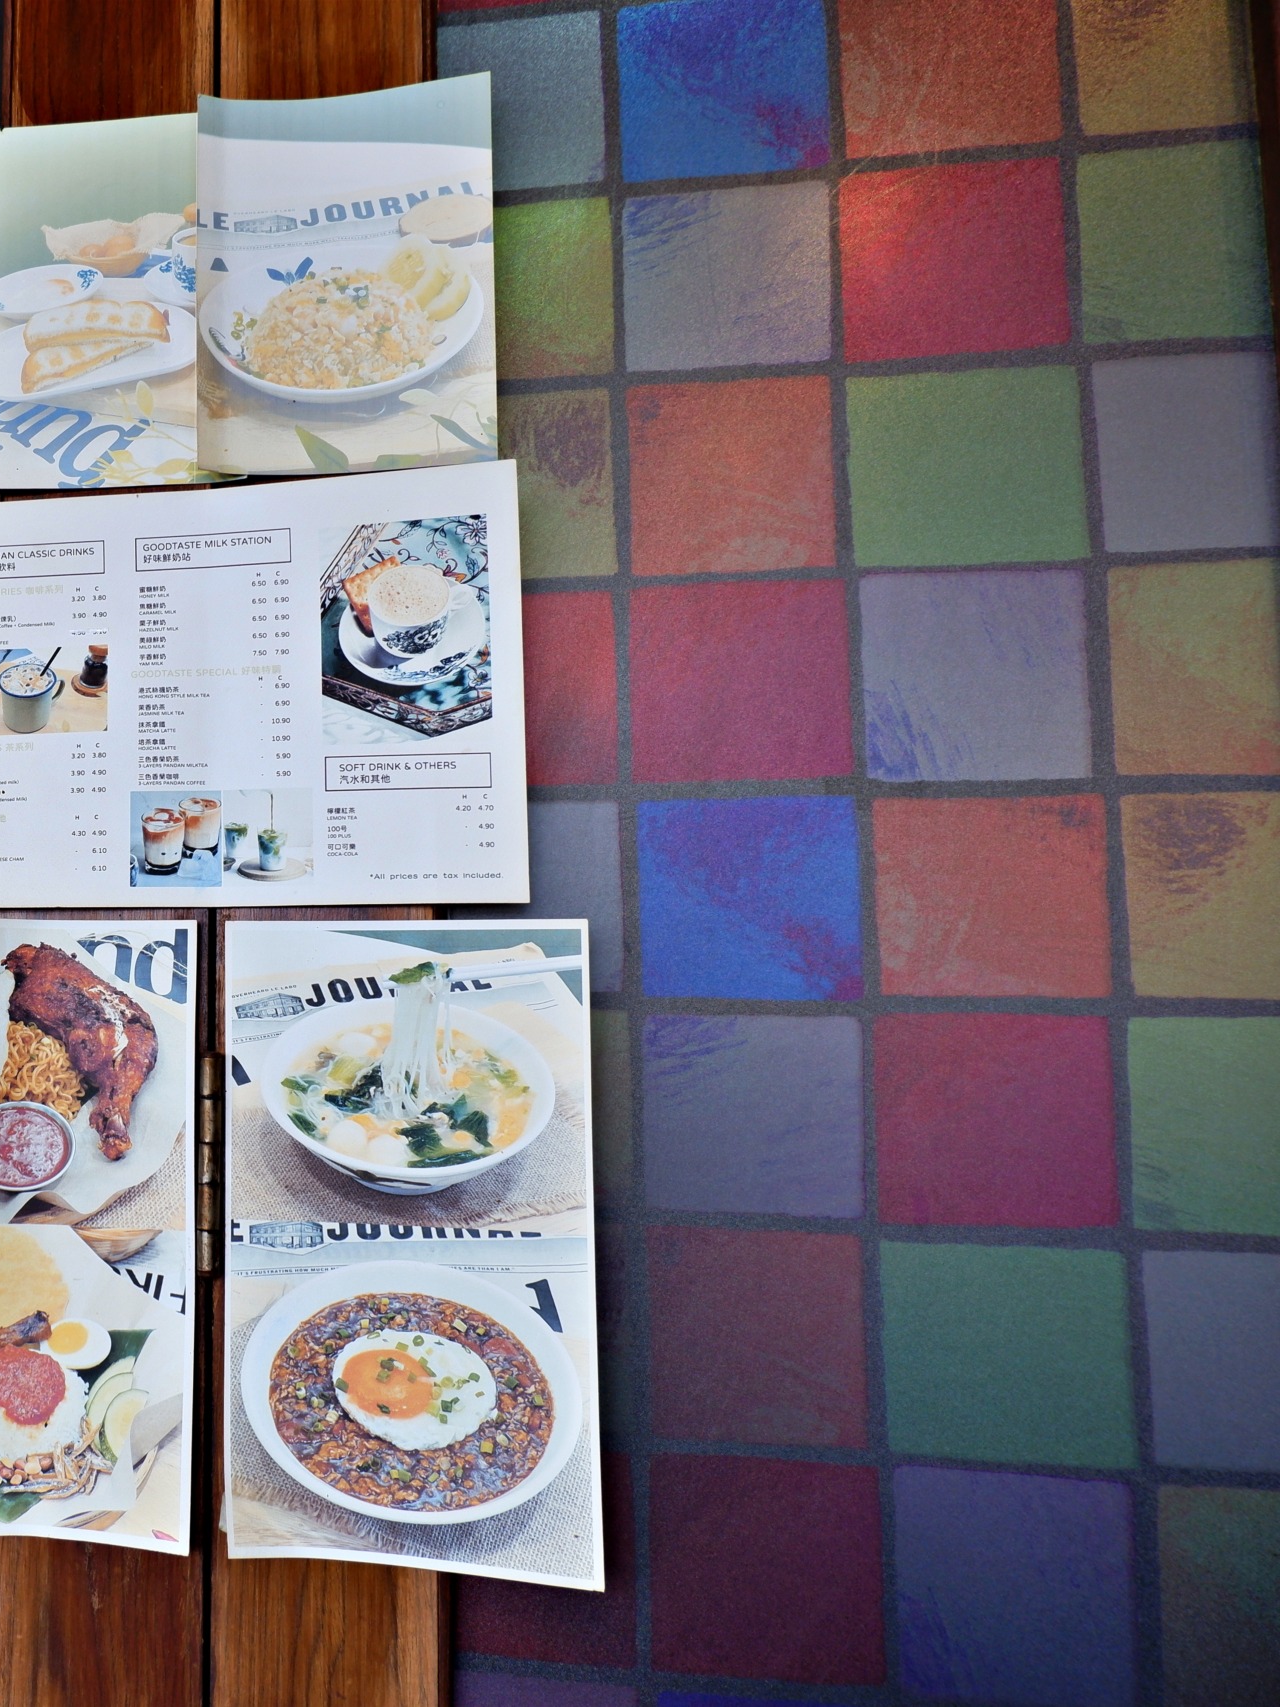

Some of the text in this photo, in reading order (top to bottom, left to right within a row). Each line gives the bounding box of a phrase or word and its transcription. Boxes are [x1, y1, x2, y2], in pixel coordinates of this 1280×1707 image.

[143, 536, 272, 551] GOODTASTE MILK STATION
[18, 550, 56, 558] CLASSIC
[59, 548, 94, 556] DRINKS
[143, 553, 191, 564] 好味鮮奶站
[131, 669, 192, 679] GOODTASTE
[196, 667, 236, 677] SPECIAL
[339, 761, 456, 772] SOFT DRINK & OTHERS
[340, 774, 390, 784] 汽水和其他
[390, 873, 418, 881] prices
